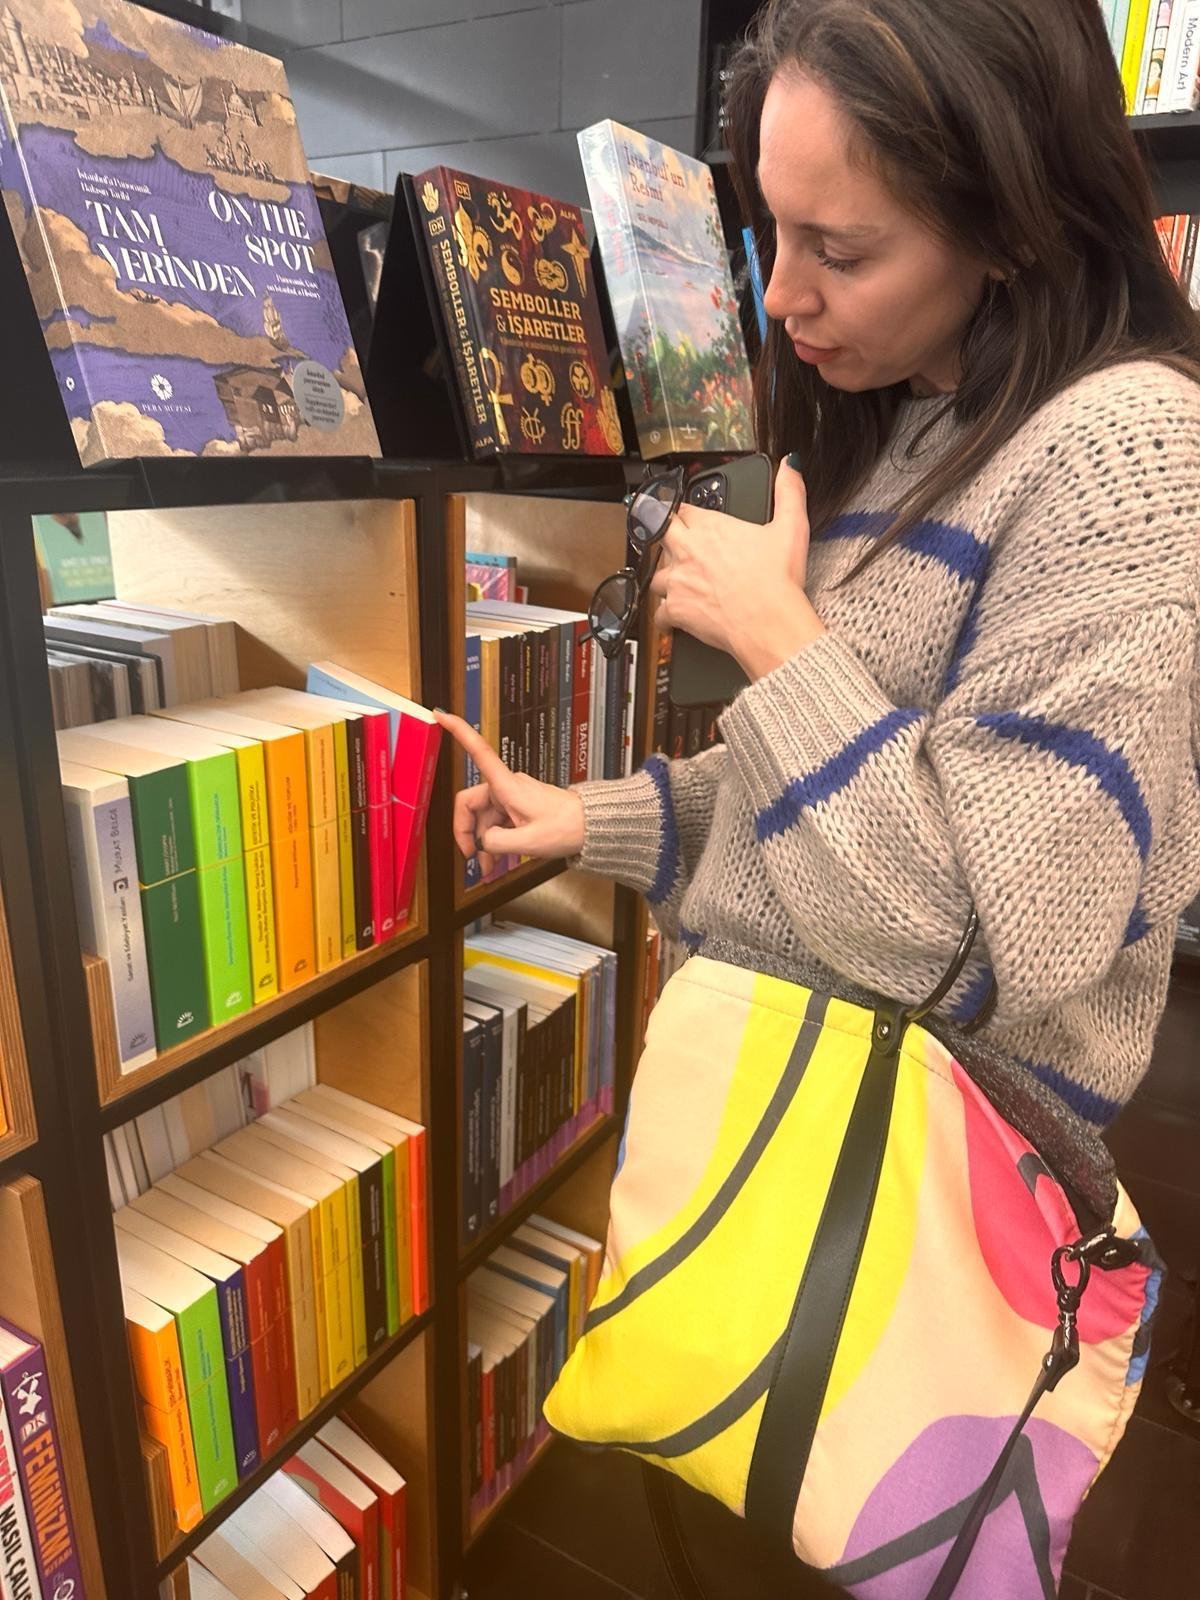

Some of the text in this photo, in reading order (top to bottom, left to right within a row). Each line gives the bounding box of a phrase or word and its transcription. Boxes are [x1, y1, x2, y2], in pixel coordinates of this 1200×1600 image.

[1176, 17, 1198, 91] Modern Art
[455, 182, 470, 199] DK
[85, 200, 165, 247] TAM
[208, 190, 311, 241] ON THE
[430, 218, 445, 234] DK
[97, 242, 257, 298] YERİNDEN
[245, 234, 316, 274] SPOT
[490, 287, 582, 321] SEMBOLLER
[496, 310, 587, 344] & İŞARETLER
[440, 239, 468, 329] SEMBOLLER
[462, 339, 487, 425] İŞARETLER
[578, 722, 588, 773] BAROK
[22, 1413, 46, 1440] DK
[23, 1429, 72, 1568] FEMİNİZM
[0, 1503, 22, 1564] NASIL
